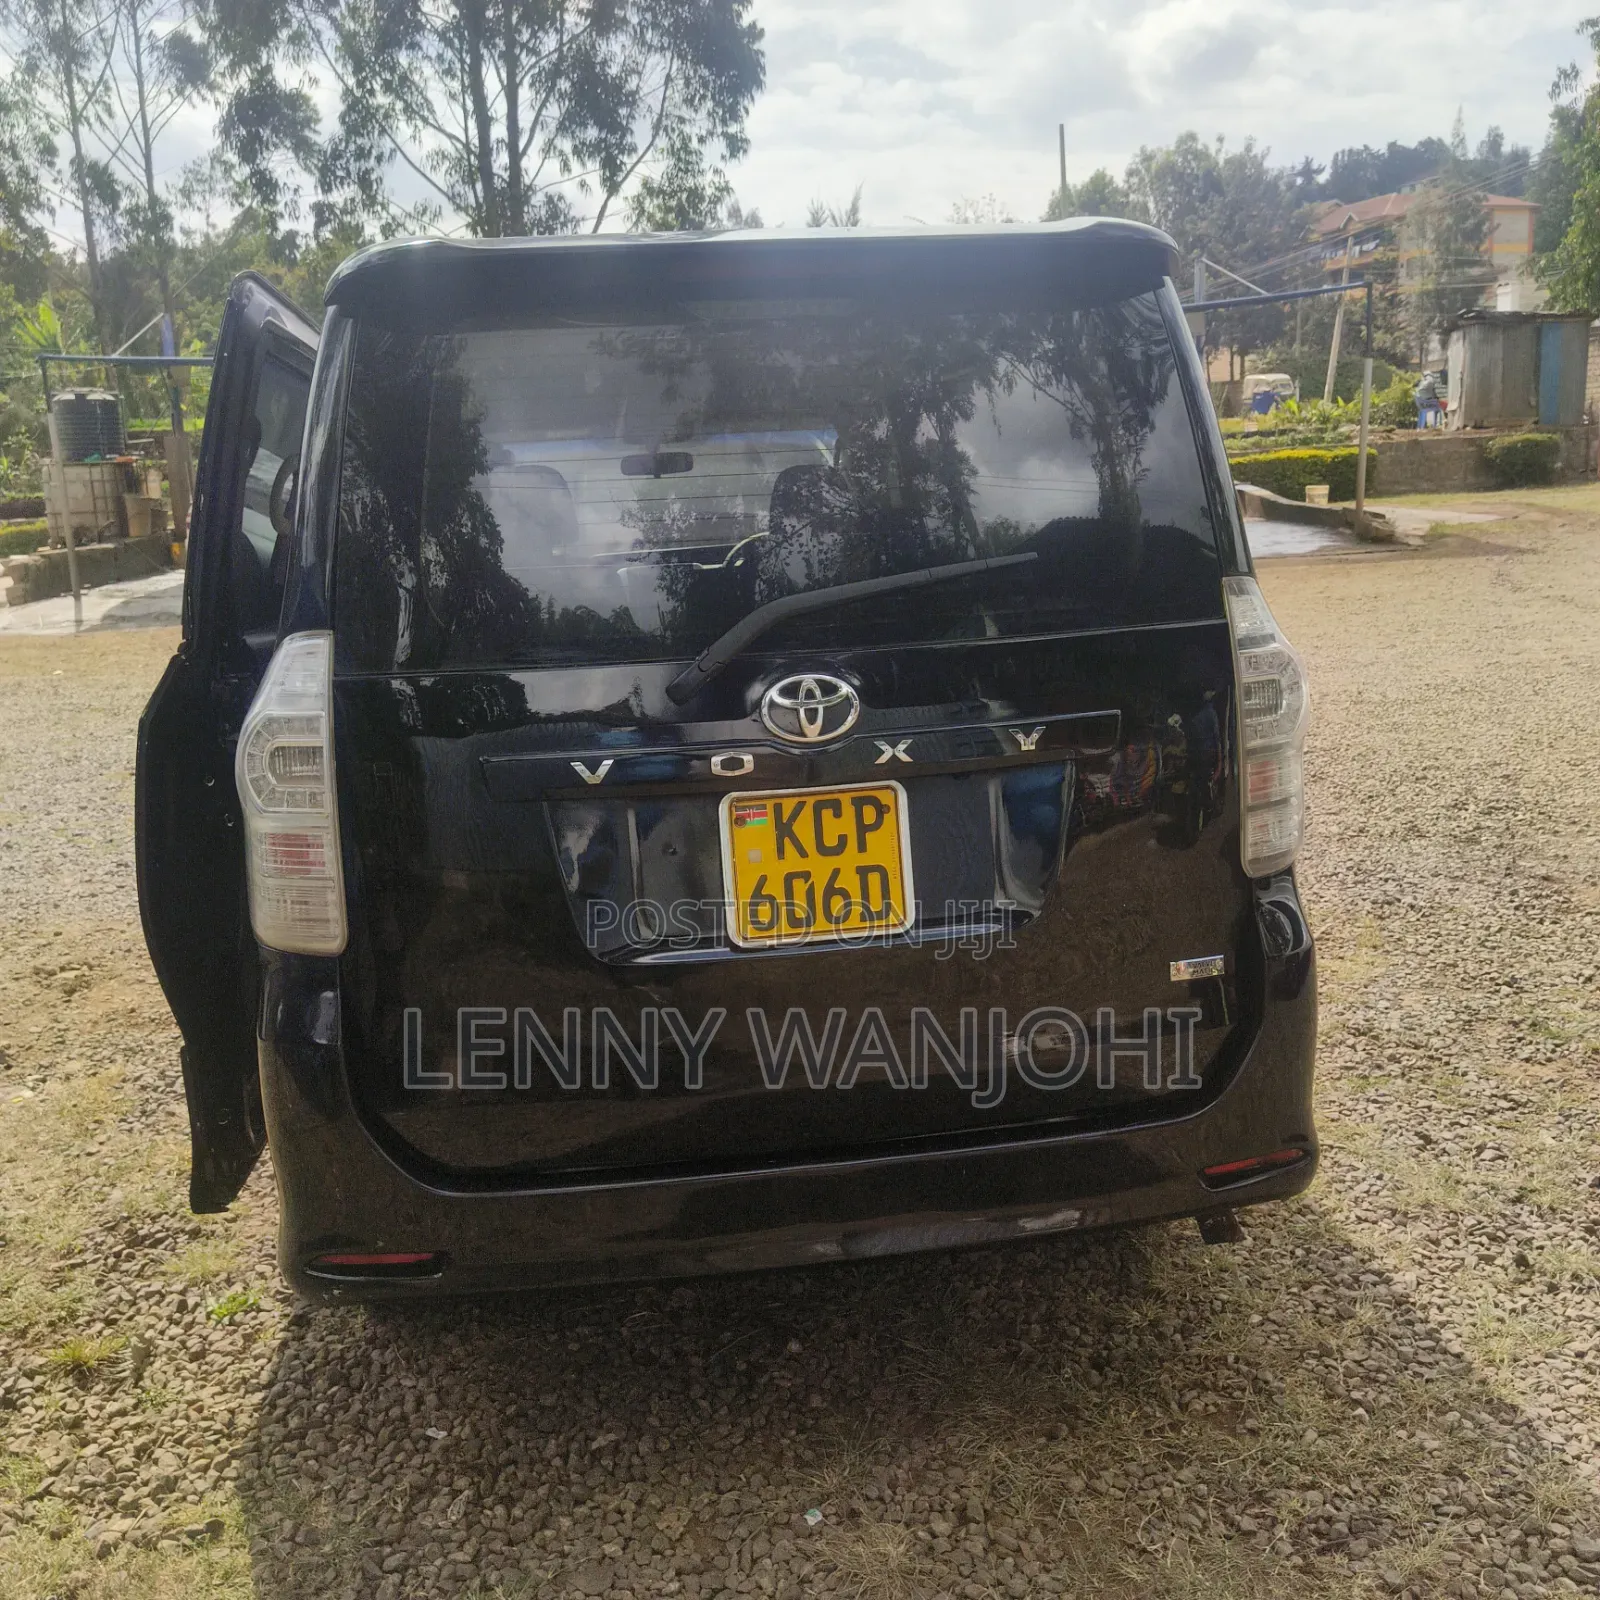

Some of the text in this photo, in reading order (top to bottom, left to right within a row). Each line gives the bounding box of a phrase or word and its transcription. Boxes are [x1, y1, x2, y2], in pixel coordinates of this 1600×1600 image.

[570, 726, 1047, 784] VOXY
[773, 795, 885, 861] KCP
[748, 864, 893, 932] 606D
